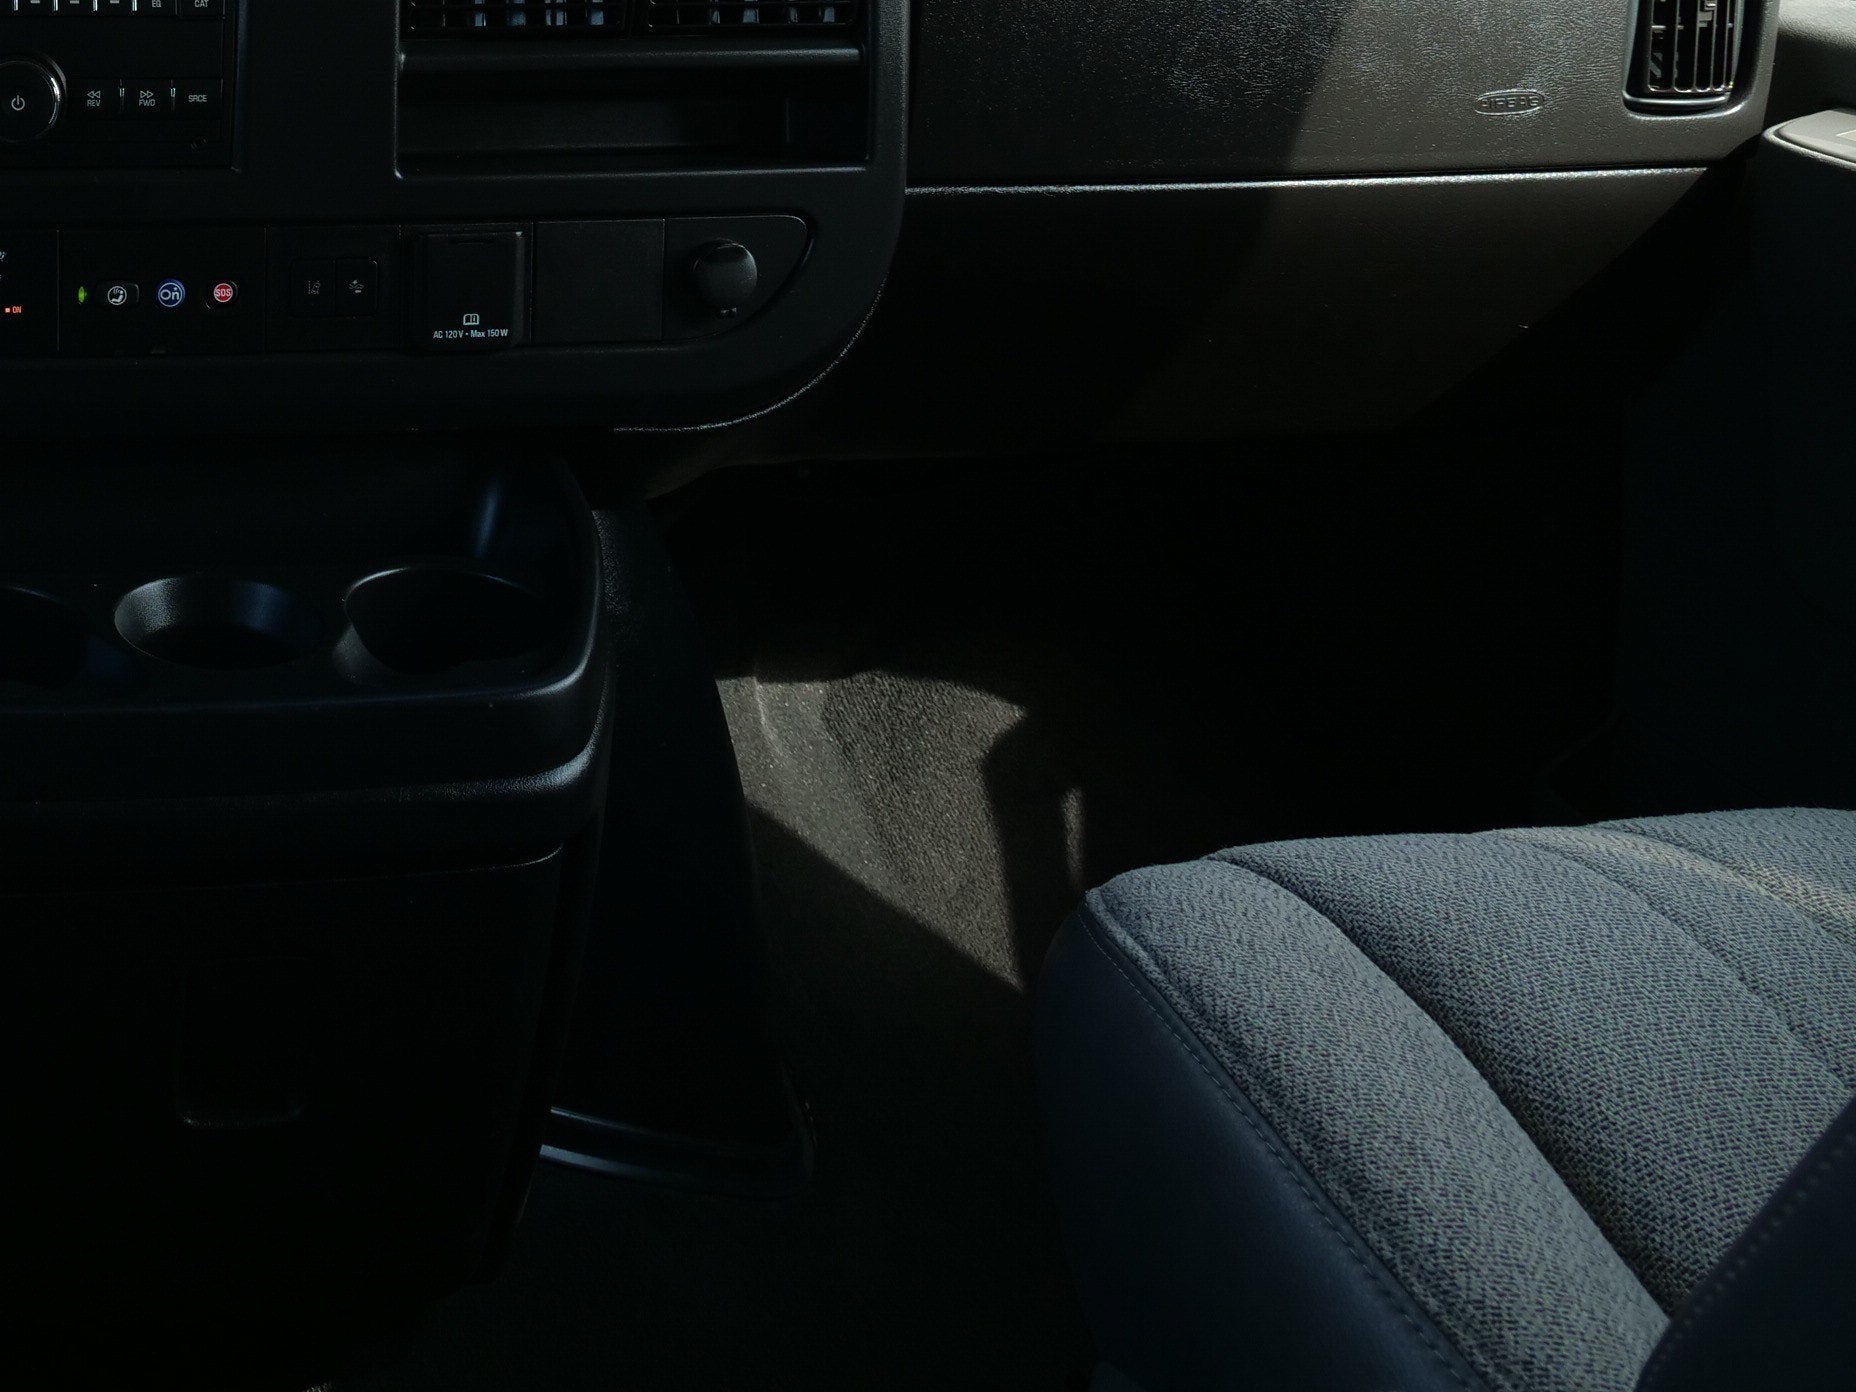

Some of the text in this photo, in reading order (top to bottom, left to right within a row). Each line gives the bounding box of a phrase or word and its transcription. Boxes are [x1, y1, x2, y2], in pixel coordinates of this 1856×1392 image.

[215, 288, 232, 297] SOS
[12, 306, 22, 314] ON
[433, 331, 443, 339] AC
[470, 330, 486, 338] Max
